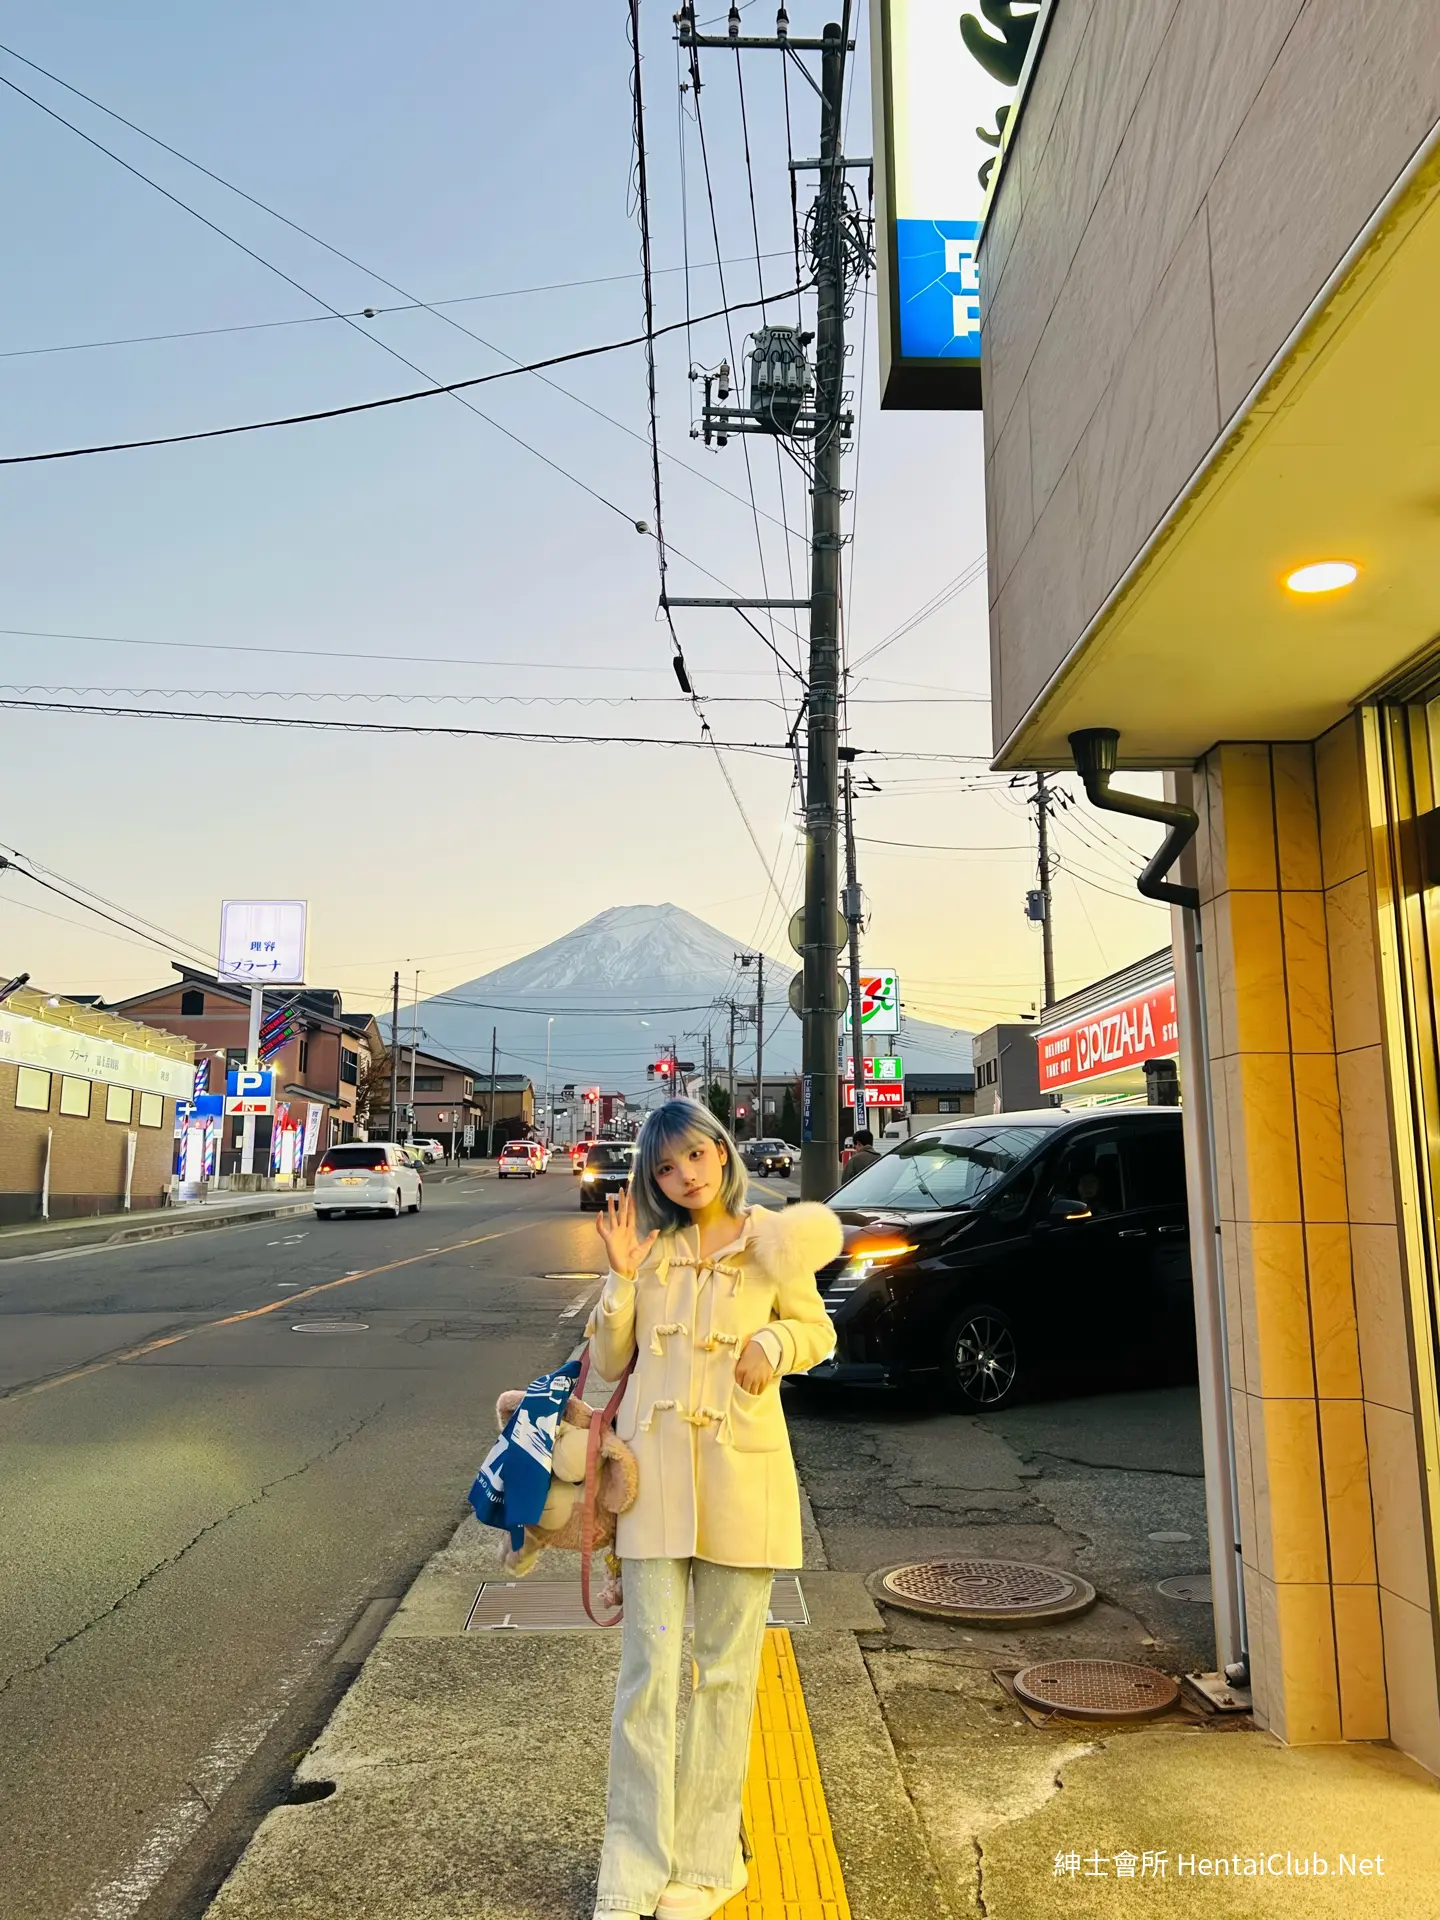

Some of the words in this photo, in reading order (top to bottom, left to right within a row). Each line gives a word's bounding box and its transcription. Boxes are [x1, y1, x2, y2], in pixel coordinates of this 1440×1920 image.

[879, 1059, 896, 1078] 酒
[1046, 1062, 1059, 1078] TAKE
[237, 1072, 262, 1095] P
